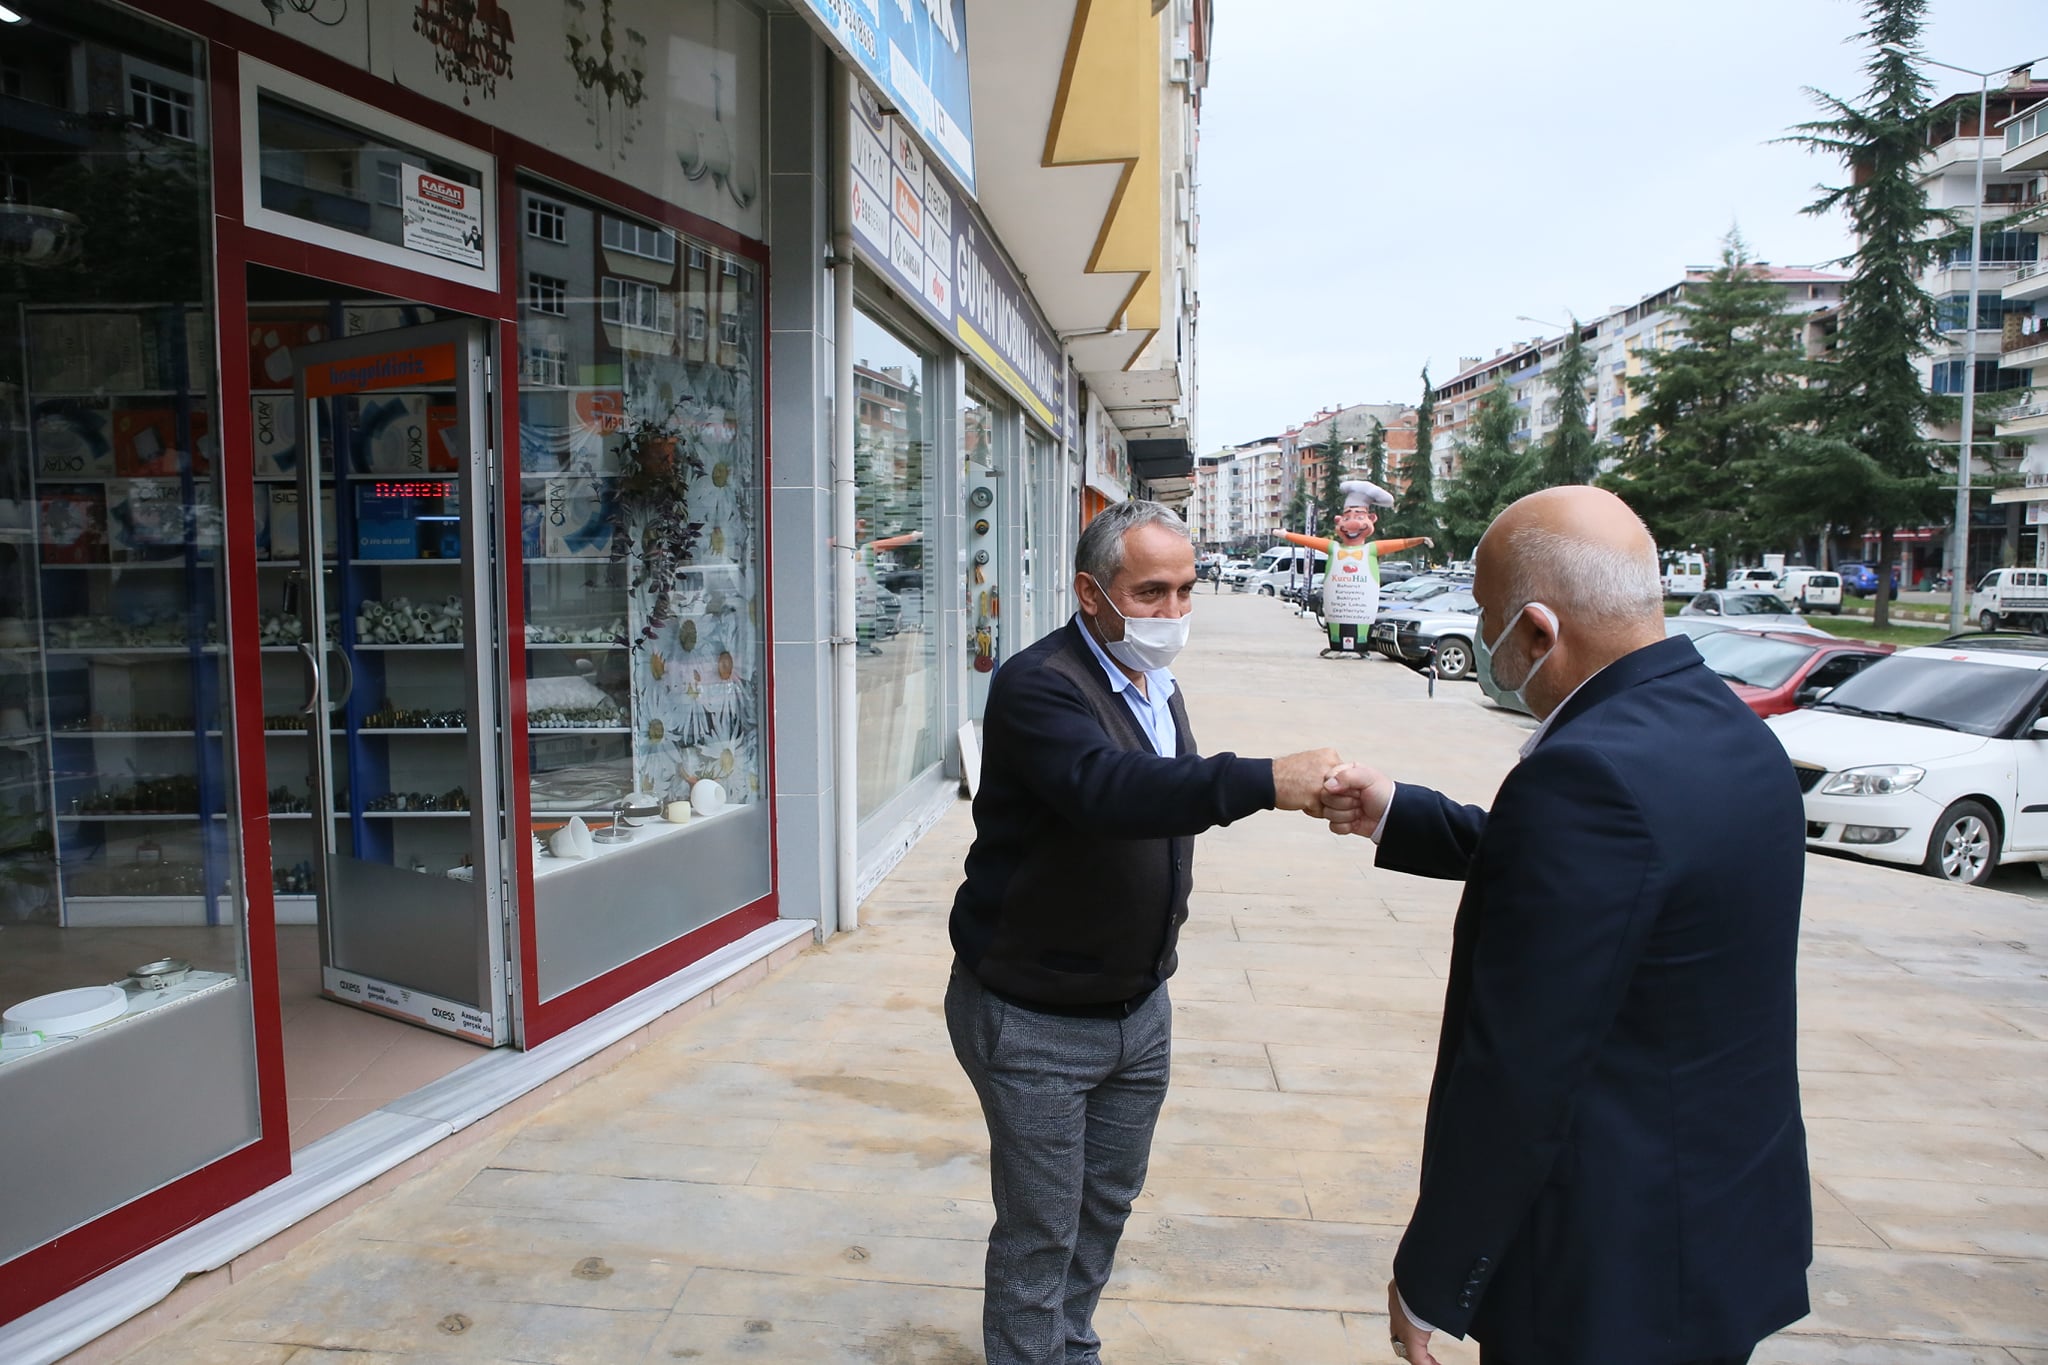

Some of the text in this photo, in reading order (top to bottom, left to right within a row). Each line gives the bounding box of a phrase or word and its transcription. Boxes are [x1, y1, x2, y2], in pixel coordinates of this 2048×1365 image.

[855, 125, 885, 193] VitrA
[926, 182, 949, 228] creavit
[957, 224, 995, 340] GÜVEN
[997, 285, 1030, 380] MOBİLYA
[258, 401, 275, 446] OKTAY
[406, 424, 422, 470] OKTAY
[550, 482, 565, 527] OKTAY
[340, 980, 361, 994] axess
[431, 1007, 456, 1022] axess
